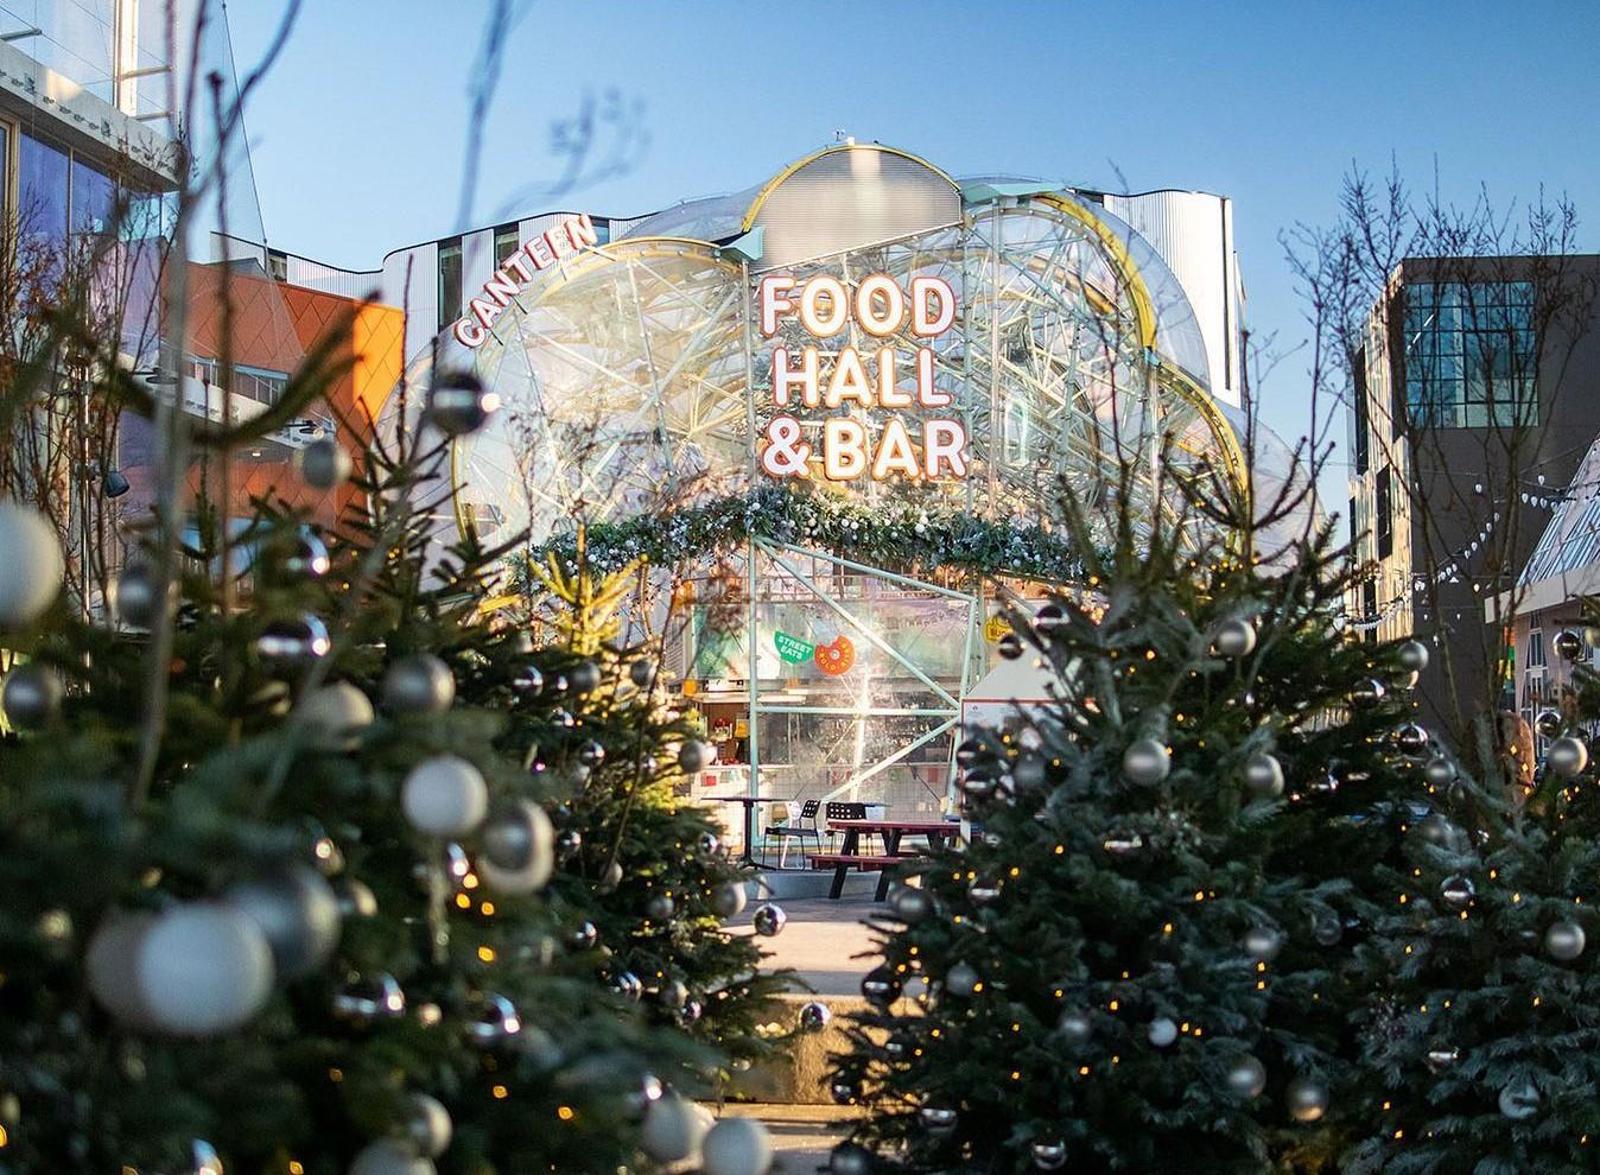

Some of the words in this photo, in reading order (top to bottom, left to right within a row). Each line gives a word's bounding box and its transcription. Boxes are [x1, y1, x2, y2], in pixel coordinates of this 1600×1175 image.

[454, 213, 597, 348] CANTEEN
[760, 274, 956, 338] FOOD
[772, 346, 953, 408] HALL
[761, 414, 811, 479] &
[824, 415, 967, 481] BAR
[778, 635, 812, 654] STREET
[780, 645, 802, 660] EATS
